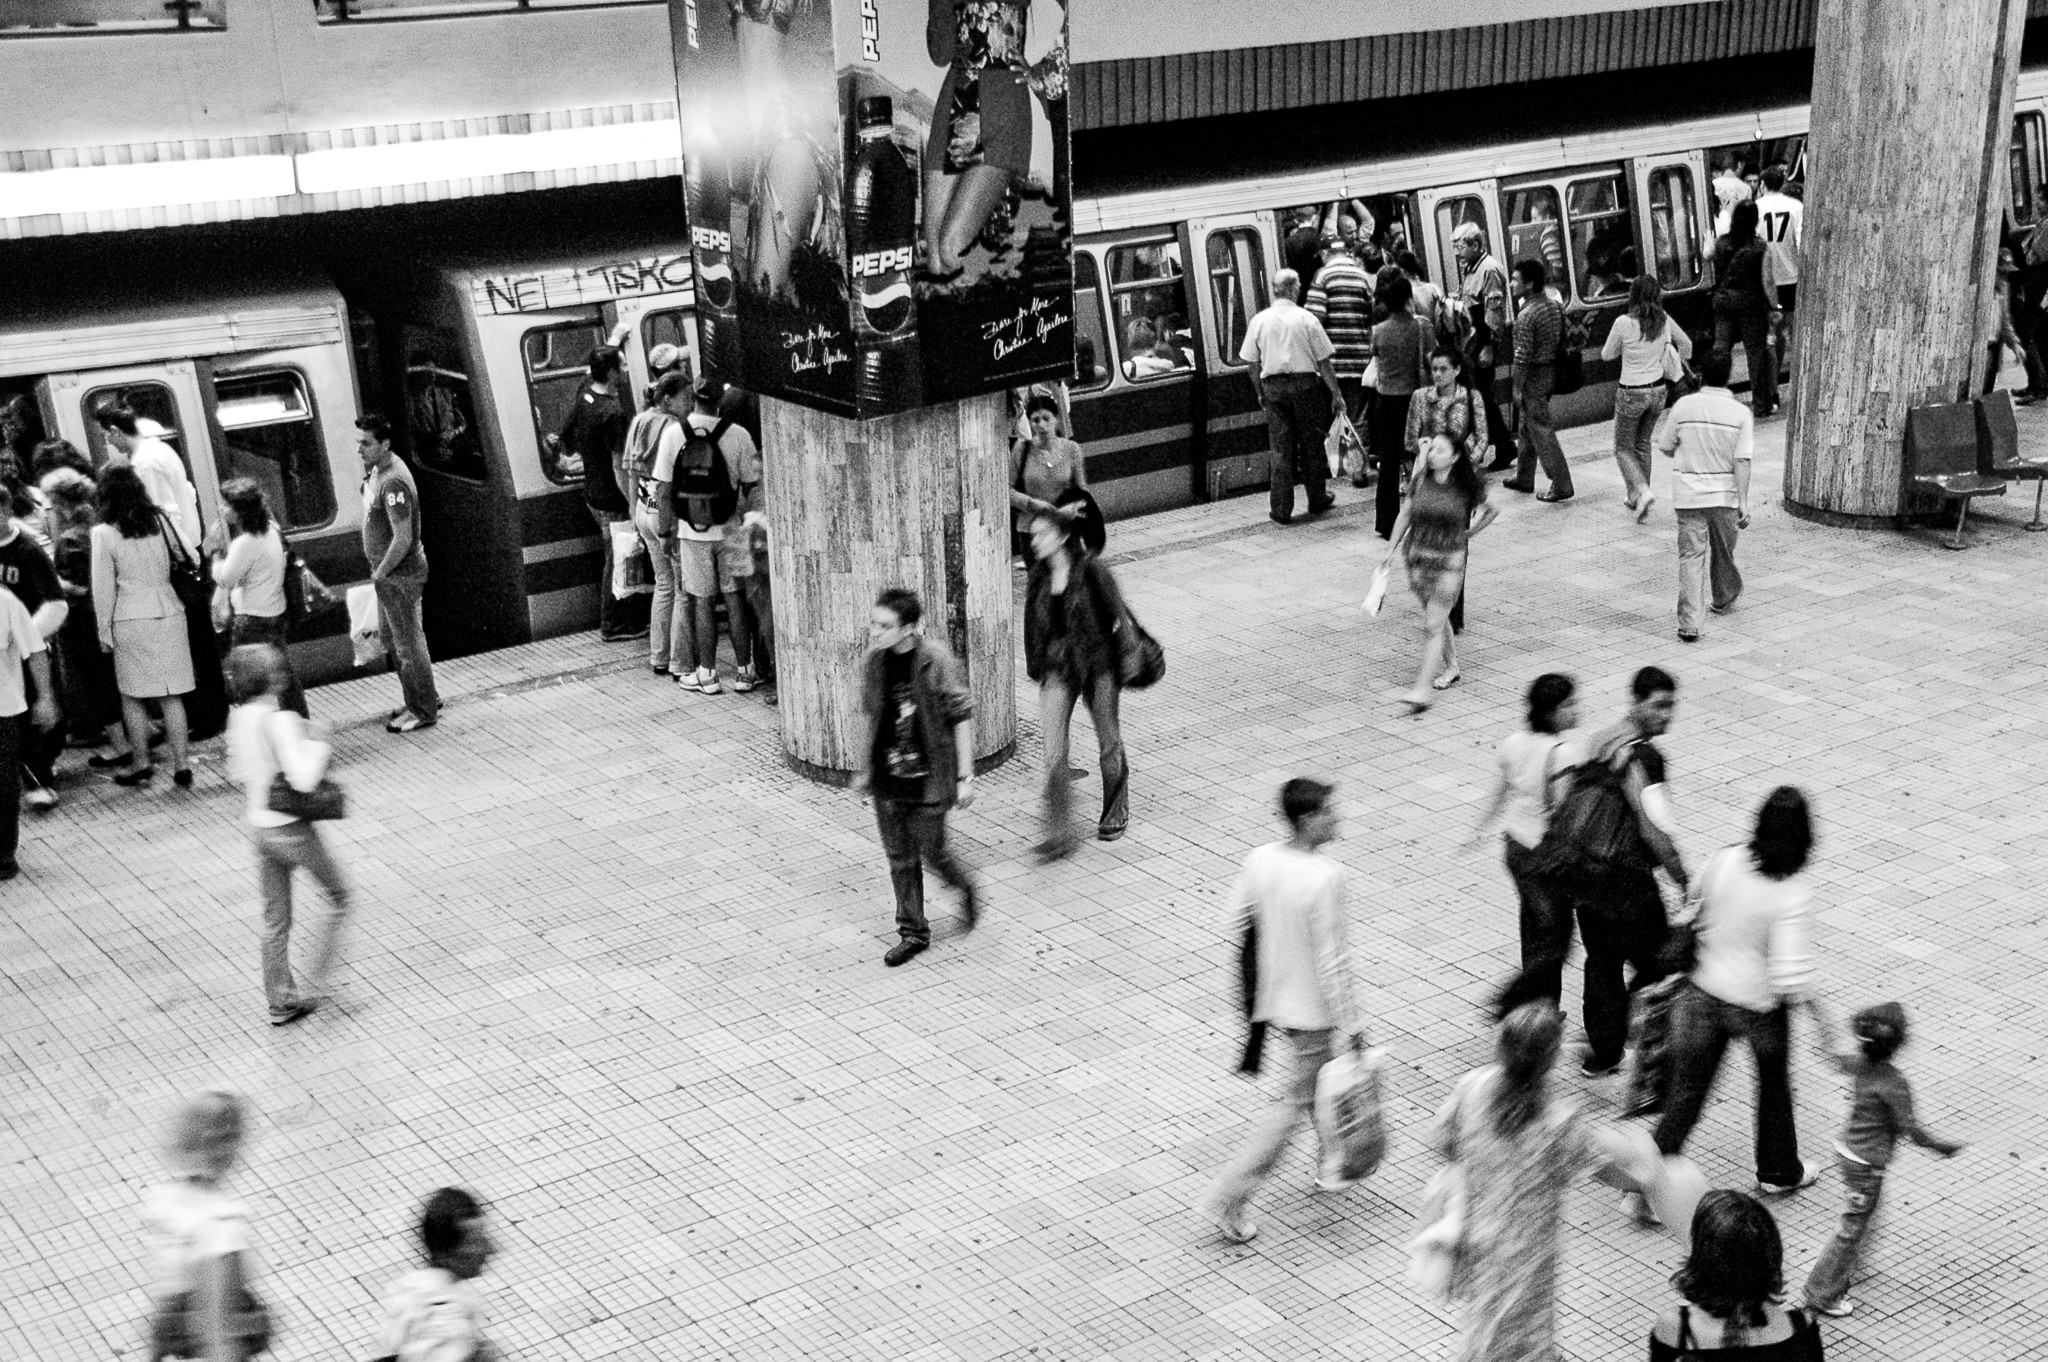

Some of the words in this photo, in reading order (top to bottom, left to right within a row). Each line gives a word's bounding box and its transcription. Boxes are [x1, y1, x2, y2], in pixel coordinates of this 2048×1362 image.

[691, 226, 731, 253] PEPSI
[1763, 211, 1791, 243] 17
[852, 246, 913, 278] PEPSI
[387, 491, 405, 507] 84
